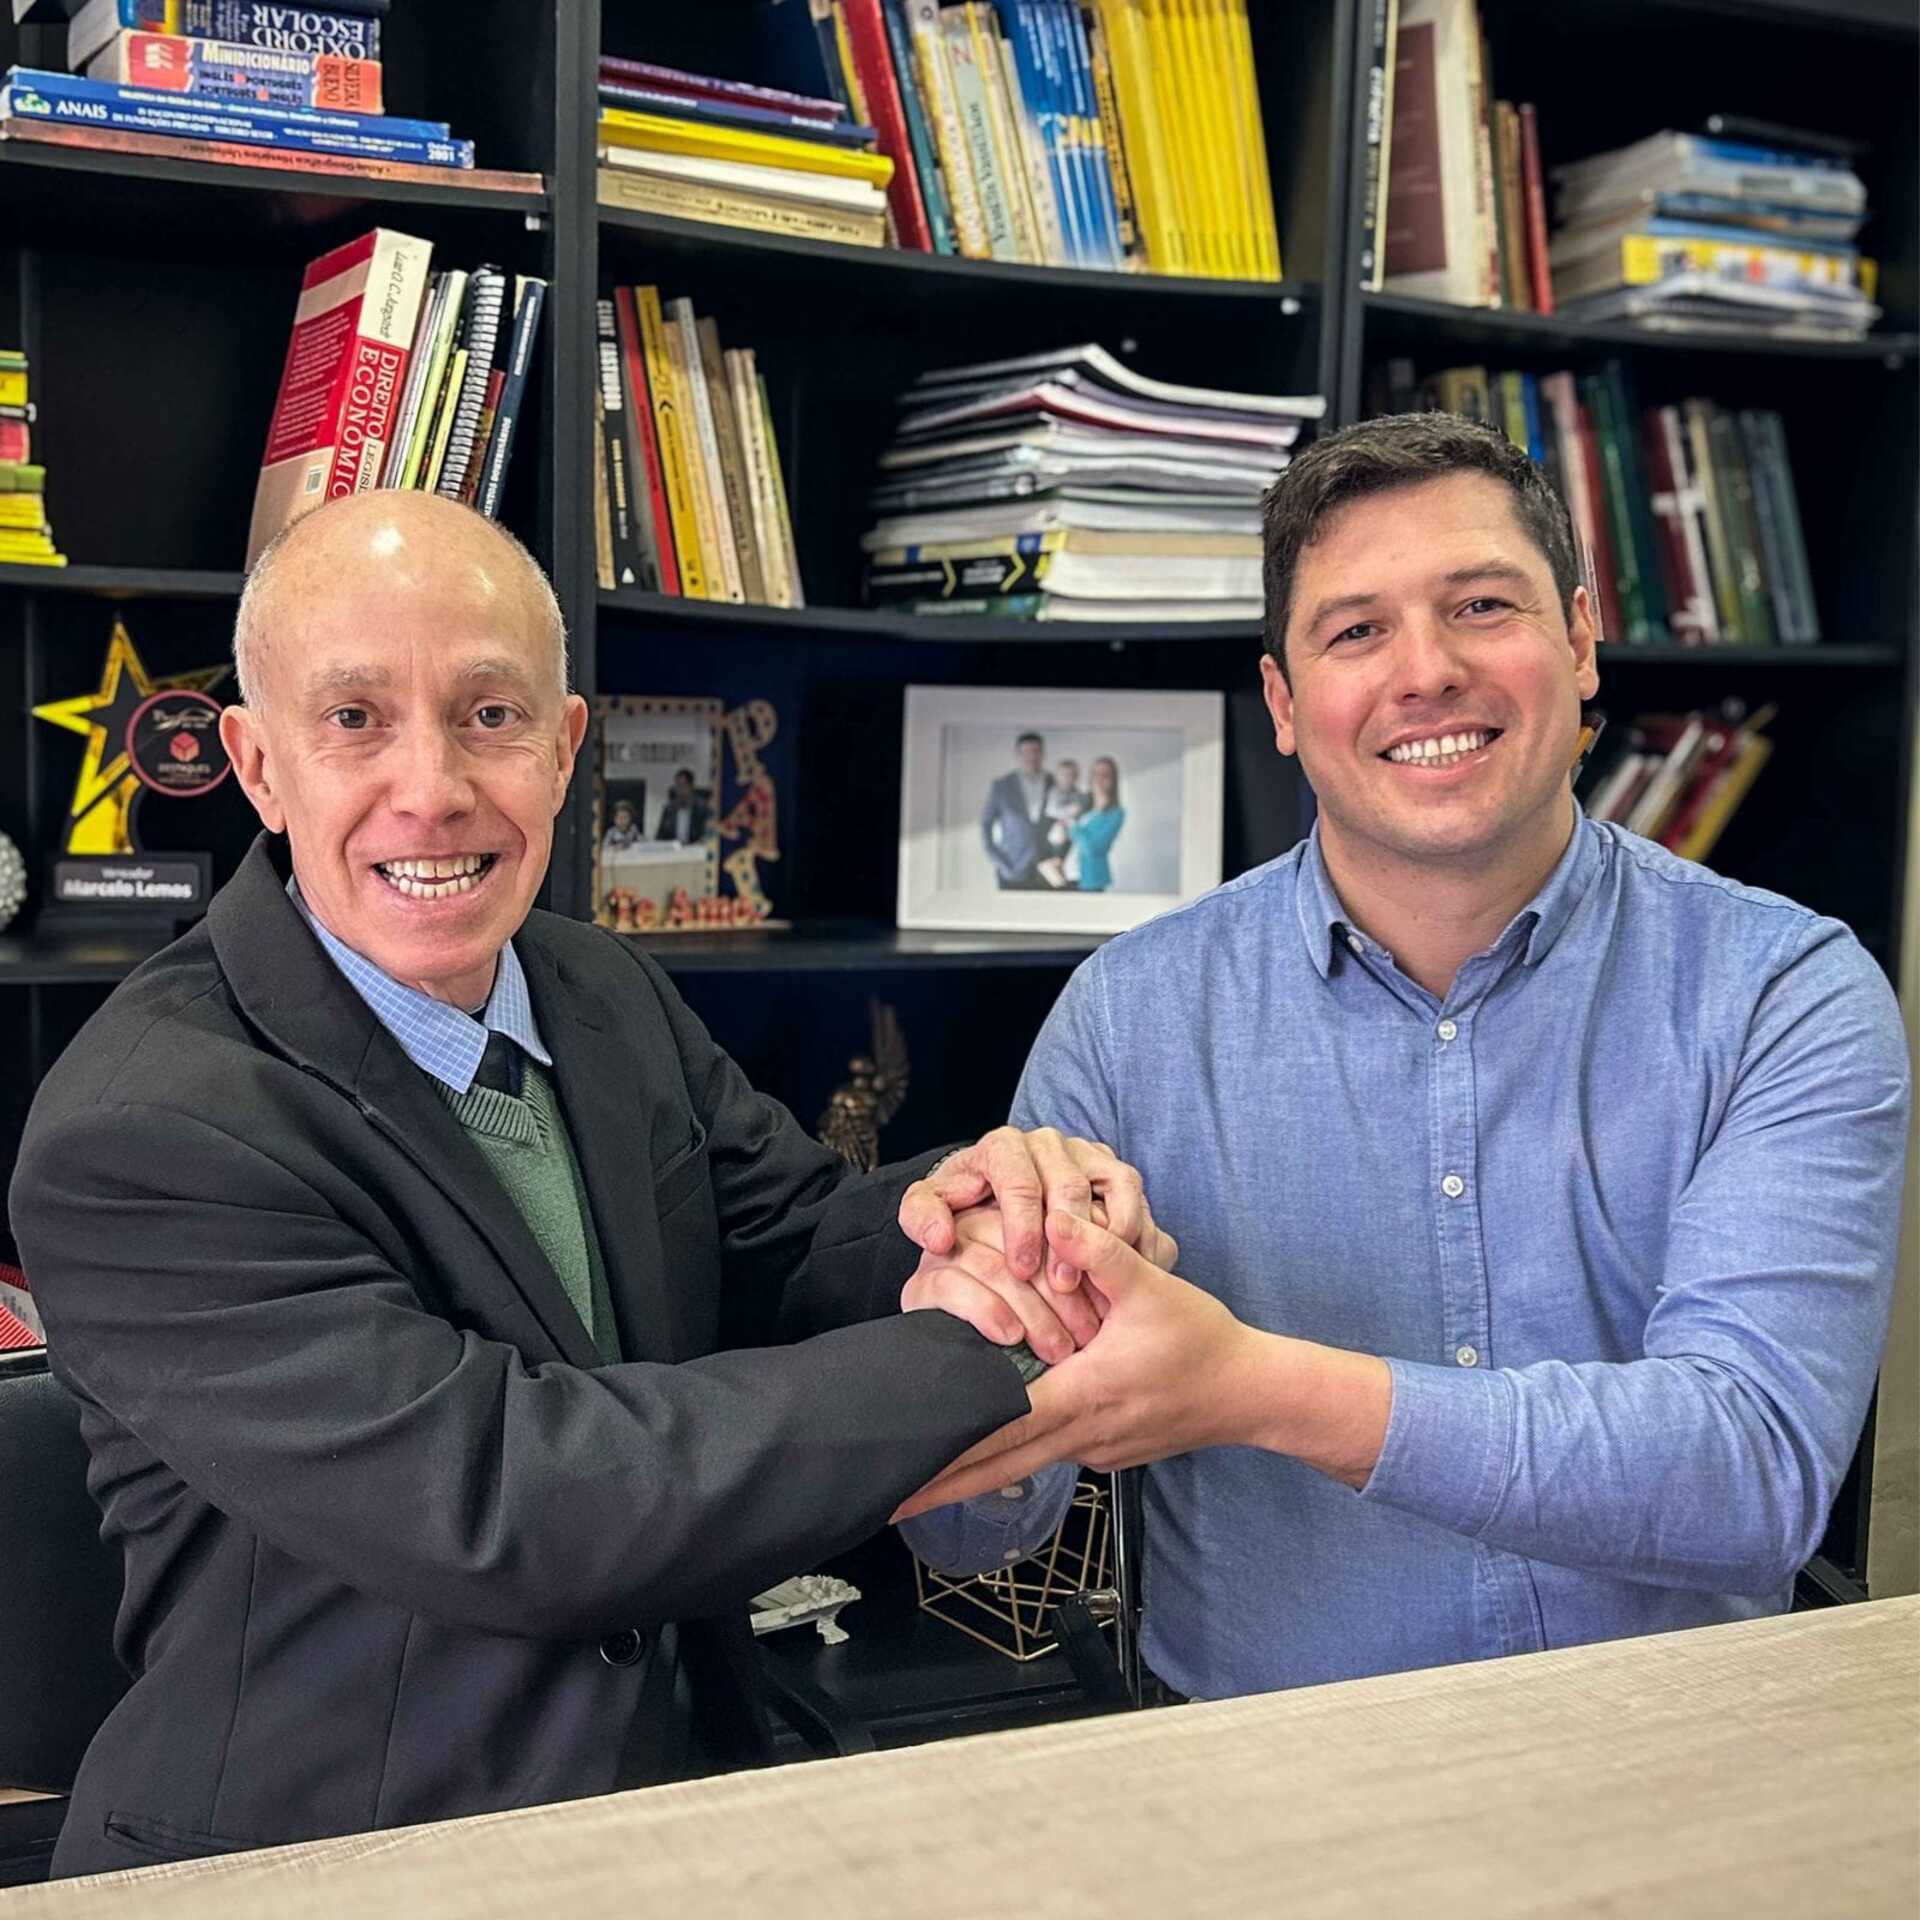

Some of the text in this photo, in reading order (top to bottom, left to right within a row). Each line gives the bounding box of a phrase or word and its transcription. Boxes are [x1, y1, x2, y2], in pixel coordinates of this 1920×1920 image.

[253, 6, 365, 43] ESCOLAR
[202, 43, 310, 75] MINIDICIONÁRIO
[252, 28, 366, 61] OXFORD
[56, 101, 108, 120] ANAIS
[427, 149, 454, 162] 2001
[597, 299, 623, 412] CLINT EASTWOOD
[366, 352, 400, 439] DIREITO
[63, 878, 192, 899] Marcelo Lemos
[608, 887, 757, 928] Te Amo
